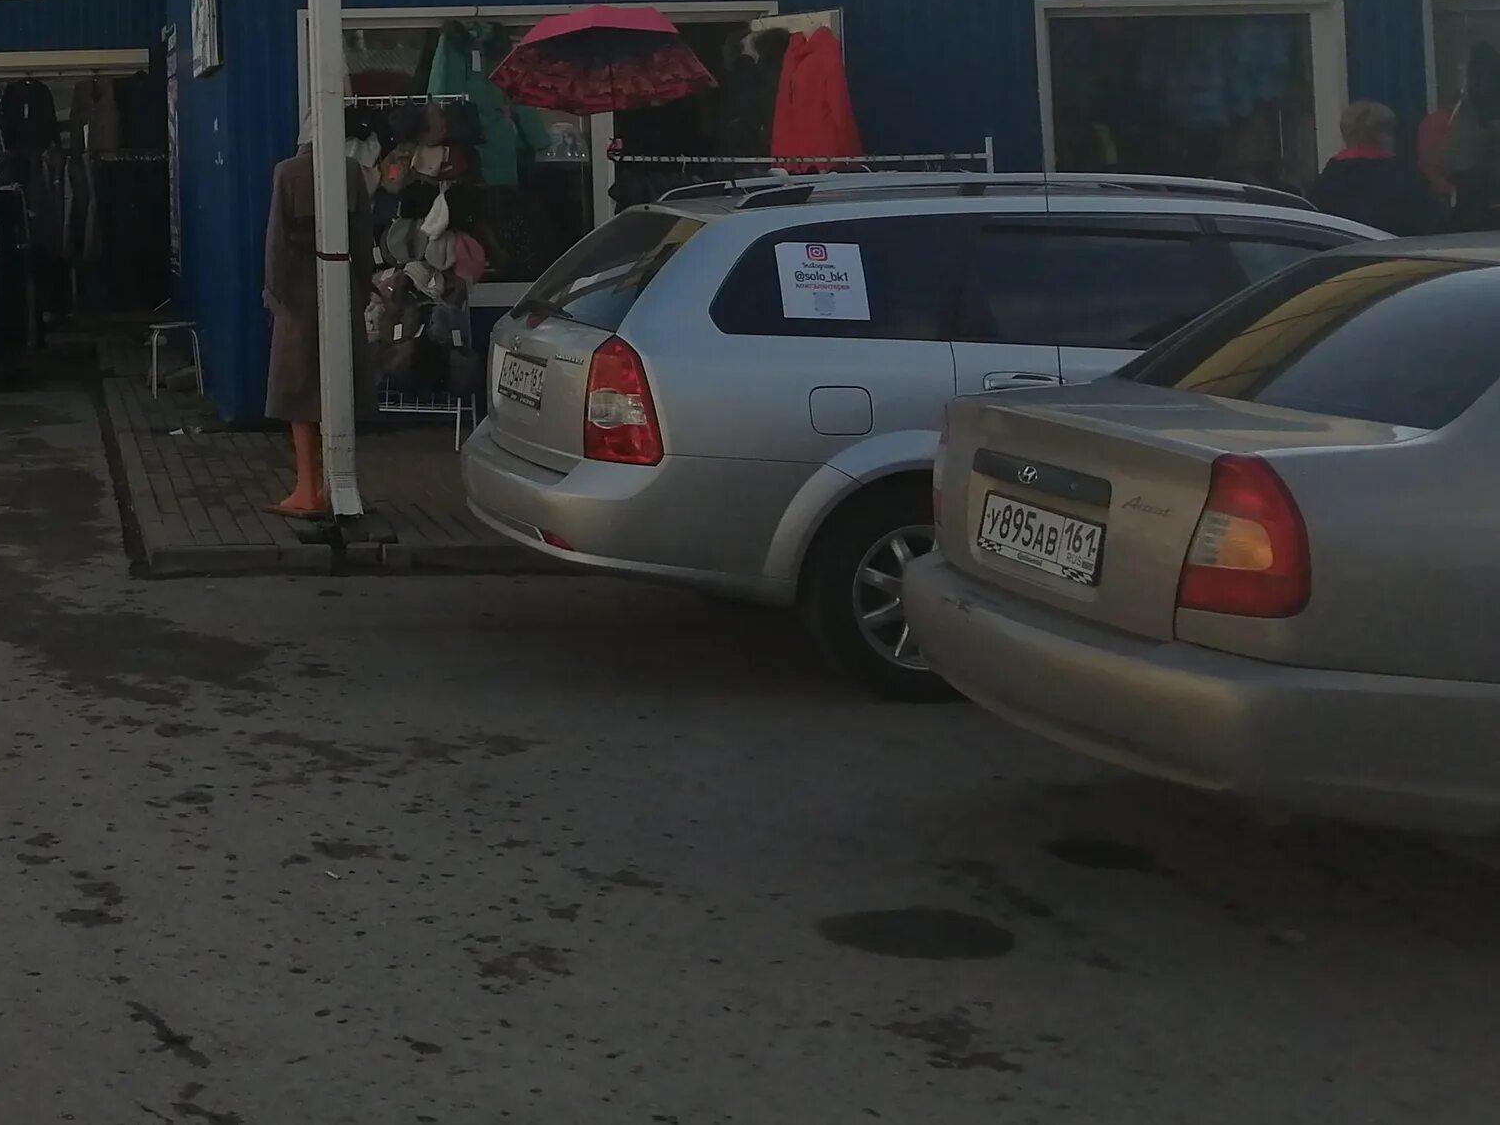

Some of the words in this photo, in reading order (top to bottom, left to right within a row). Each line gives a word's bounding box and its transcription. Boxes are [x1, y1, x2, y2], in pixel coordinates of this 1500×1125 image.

[794, 270, 849, 283] @solo_bk1
[988, 504, 1059, 555] У895АВ
[1064, 522, 1097, 557] 161
